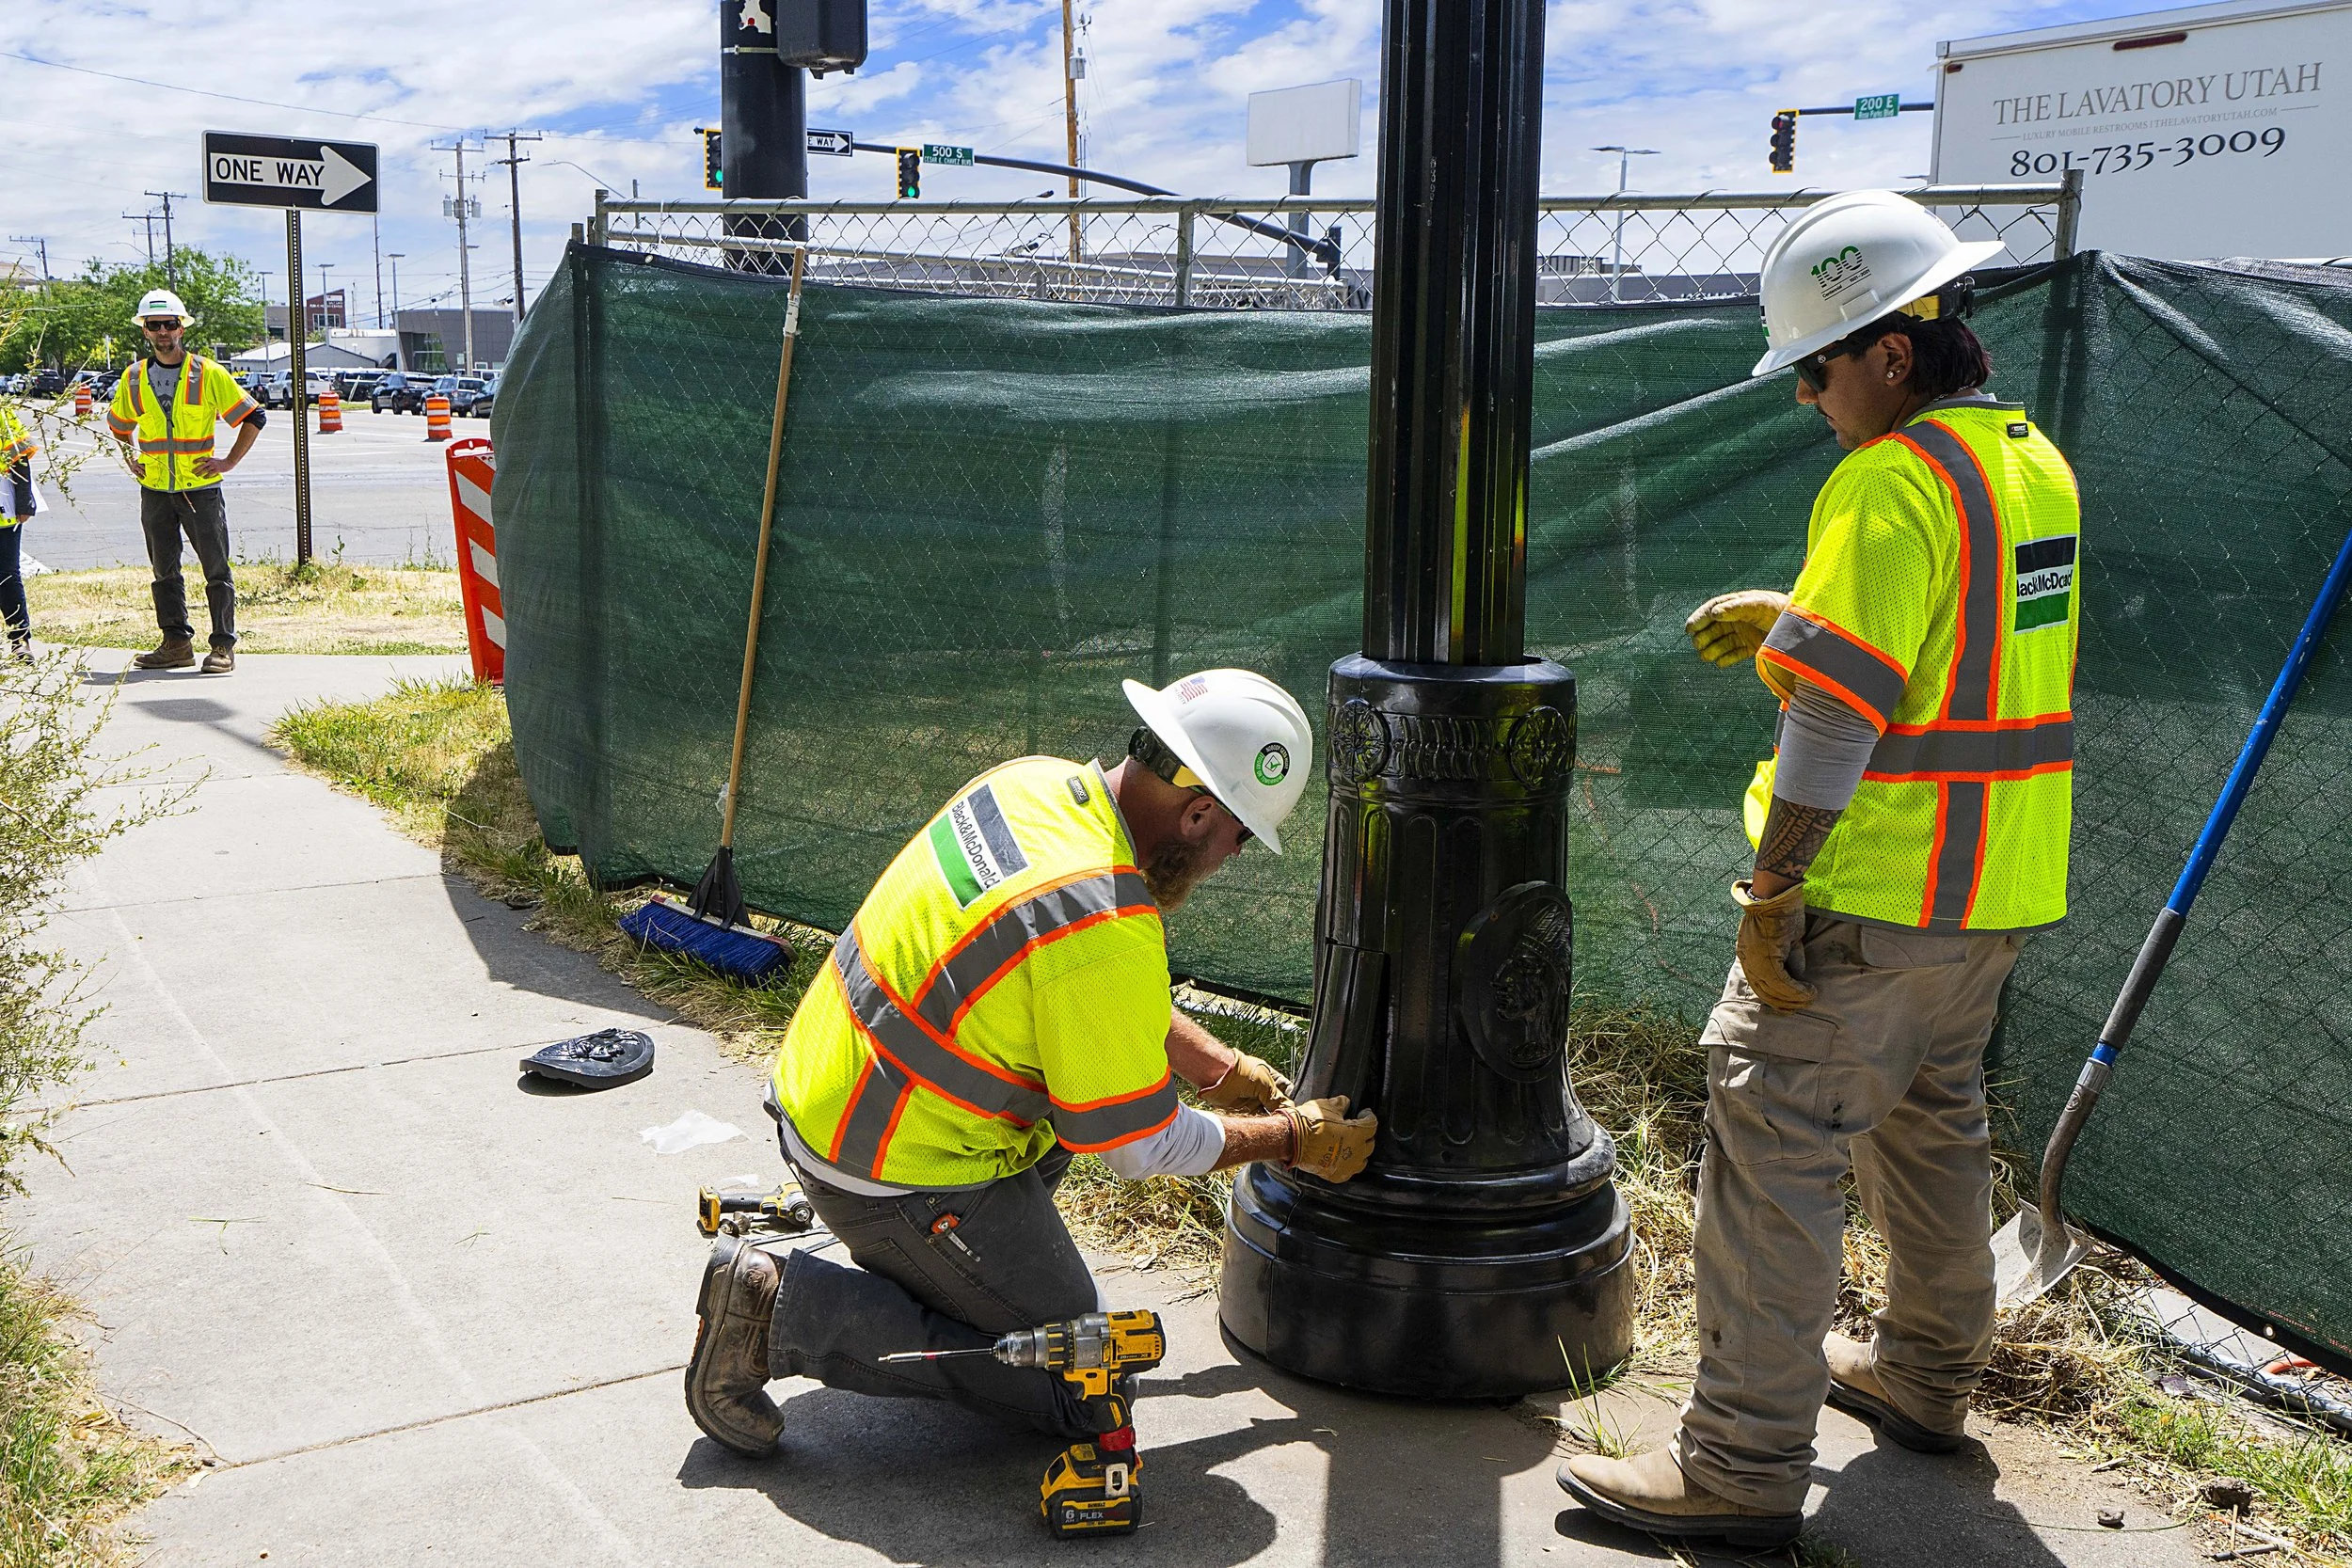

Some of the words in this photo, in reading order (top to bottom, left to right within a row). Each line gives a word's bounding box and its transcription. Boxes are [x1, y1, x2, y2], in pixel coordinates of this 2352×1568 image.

[1860, 97, 1883, 111] 200
[1886, 95, 1894, 108] E
[1993, 94, 2052, 126] THE
[2057, 74, 2217, 119] LAVATORY
[2225, 61, 2323, 101] UTAH
[2023, 129, 2057, 141] LUXURY
[2058, 126, 2090, 137] MOBILE
[2093, 121, 2148, 135] RESTROOMS
[2154, 107, 2278, 128] THELAVATORYUTAH.COM
[817, 137, 834, 147] WAY
[932, 146, 952, 157] 500
[2010, 127, 2286, 177] 801-735-3009
[215, 157, 263, 182] ONE
[276, 162, 326, 186] WAY
[1811, 245, 1863, 288] 100
[951, 800, 1001, 889] Black&McDonald
[1065, 1510, 1075, 1520] 6
[1079, 1512, 1104, 1520] FLEX
